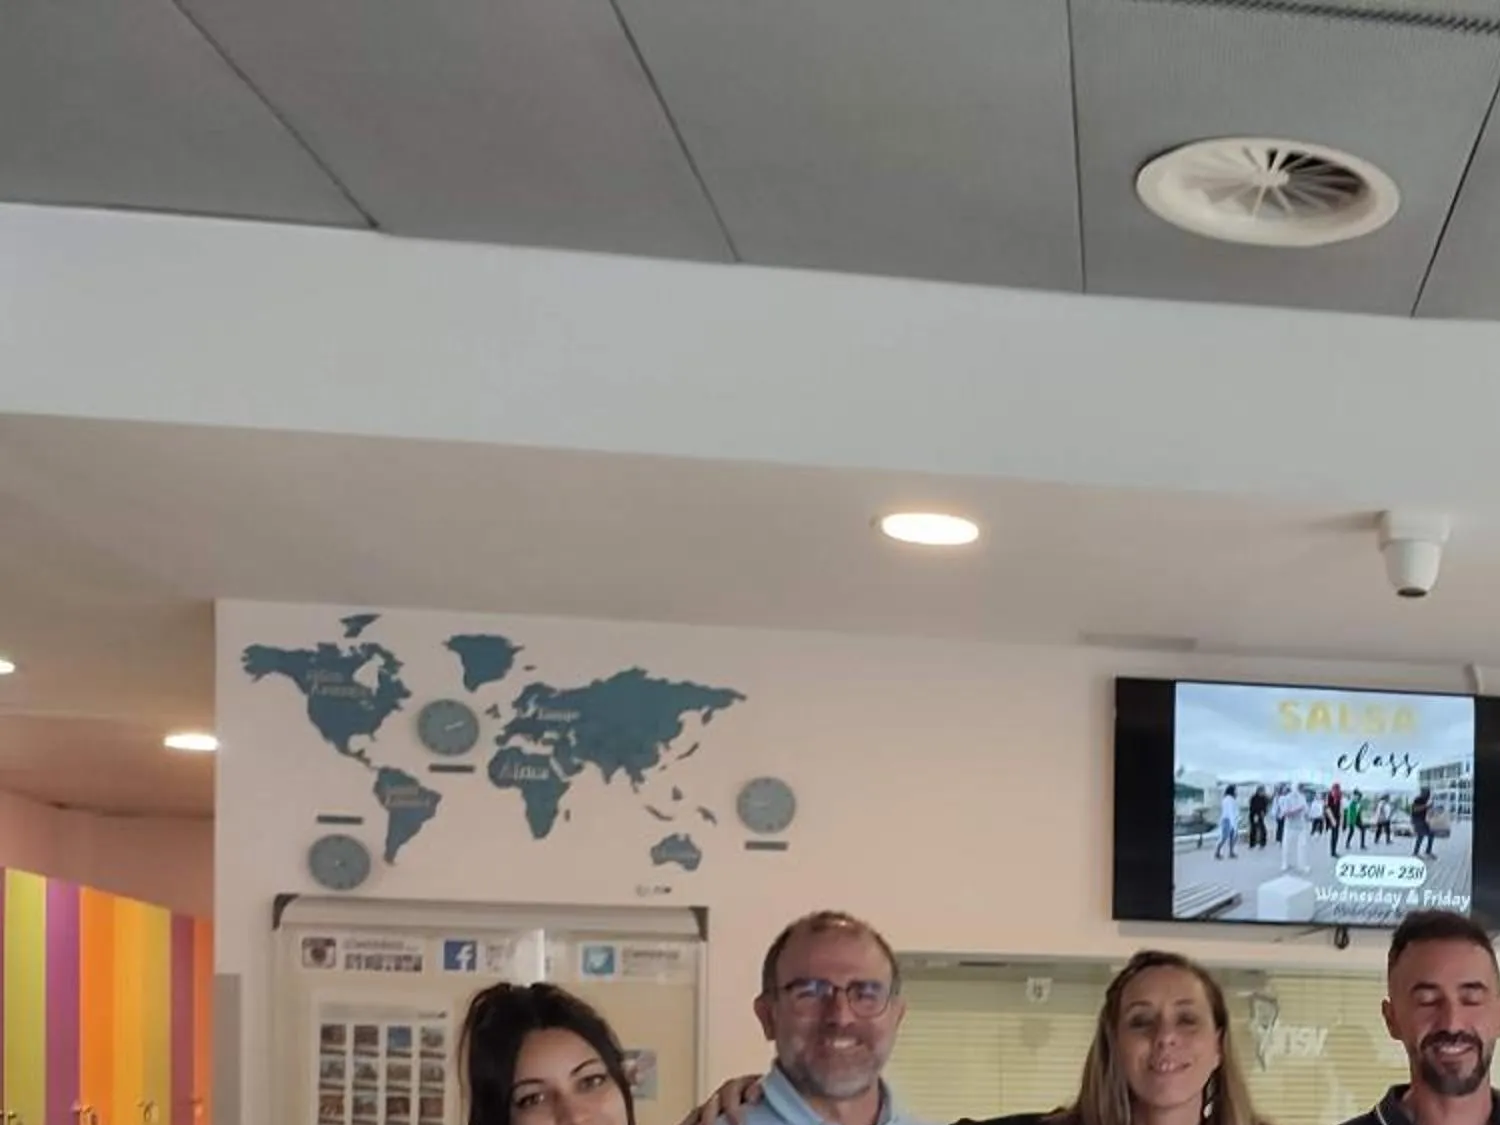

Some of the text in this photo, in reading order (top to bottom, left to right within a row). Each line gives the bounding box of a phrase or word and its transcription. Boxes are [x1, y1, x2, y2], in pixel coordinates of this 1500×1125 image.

[1278, 699, 1418, 736] SALSA
[1337, 741, 1419, 778] class
[1313, 886, 1402, 909] Wednesday
[1422, 889, 1472, 912] Friday
